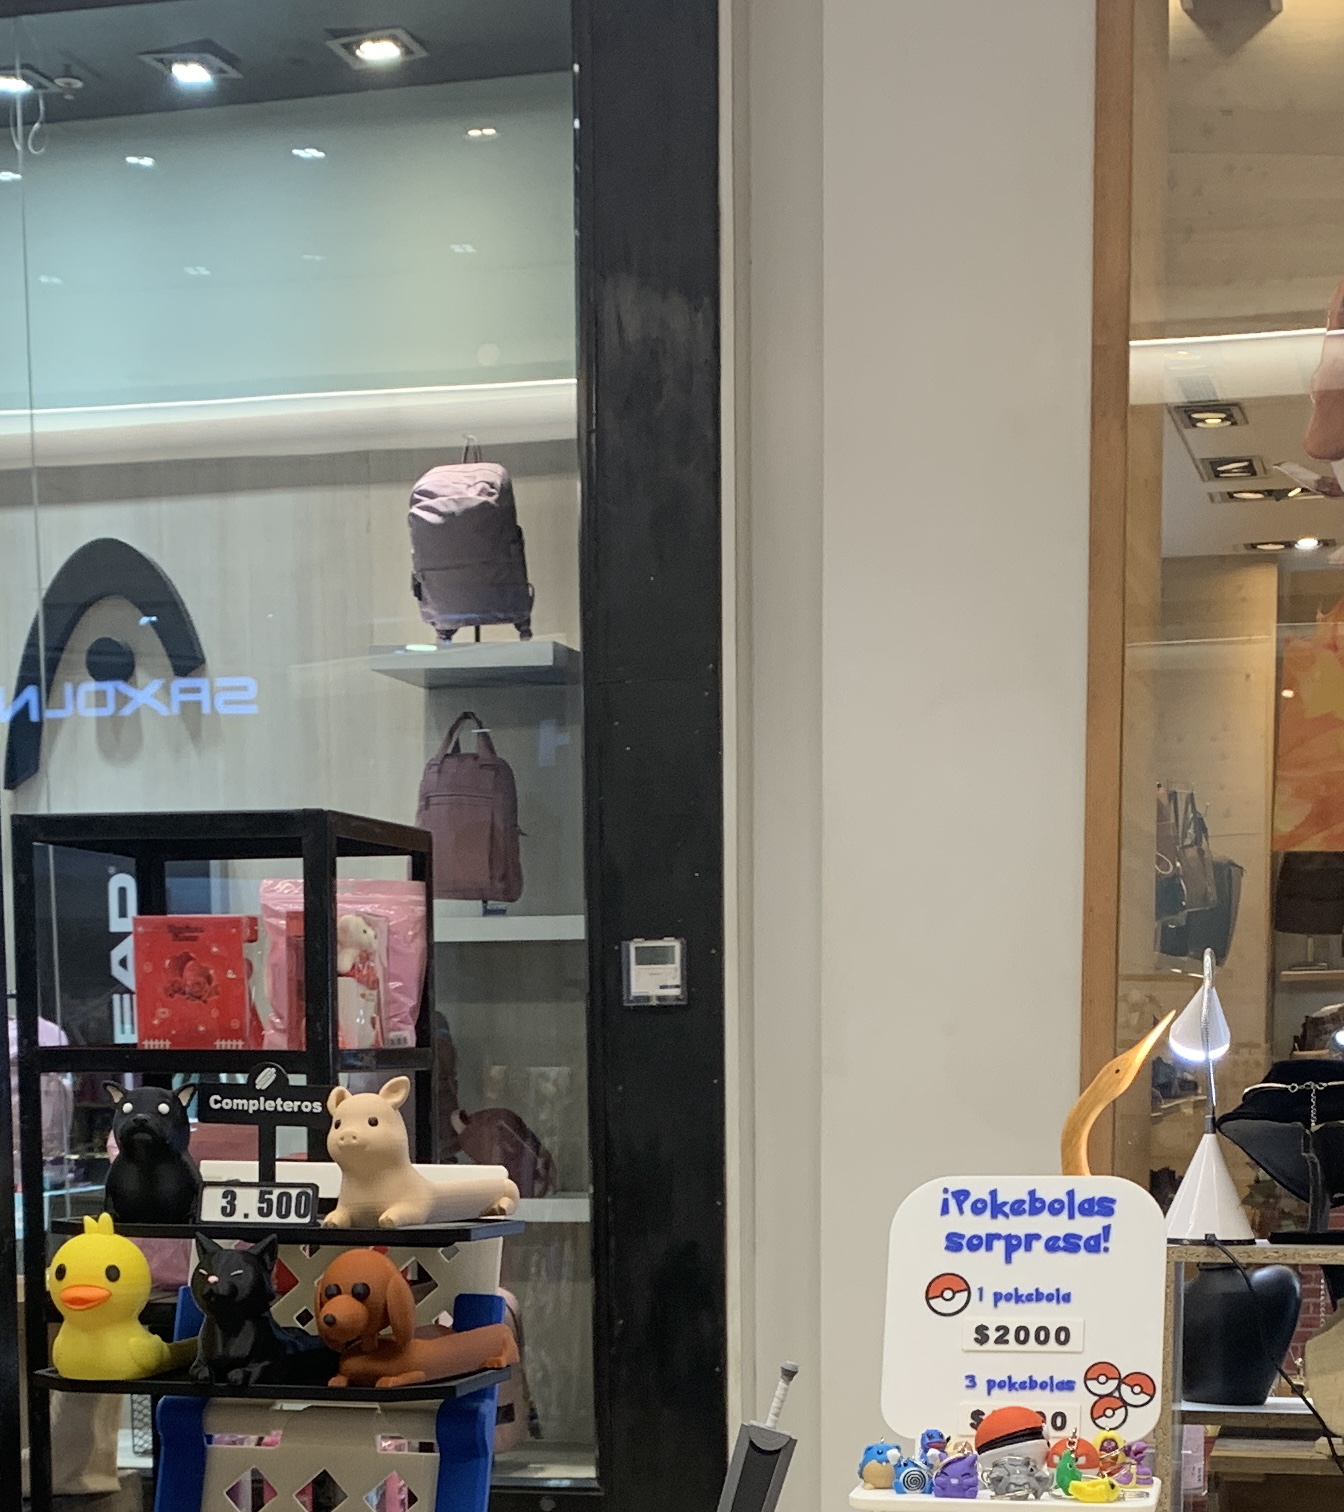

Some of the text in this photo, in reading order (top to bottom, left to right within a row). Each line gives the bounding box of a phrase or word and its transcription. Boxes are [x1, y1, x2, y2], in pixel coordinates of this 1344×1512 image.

[108, 873, 137, 1044] EAD
[209, 1094, 323, 1114] Completeros
[221, 1189, 312, 1219] 3.500
[940, 1187, 1117, 1220] ¡Pokebolas
[944, 1224, 1112, 1264] sorpresa!
[976, 1287, 1072, 1308] 1 pokebola
[973, 1324, 1071, 1346] $2000
[964, 1375, 1076, 1396] 3 pokebolas
